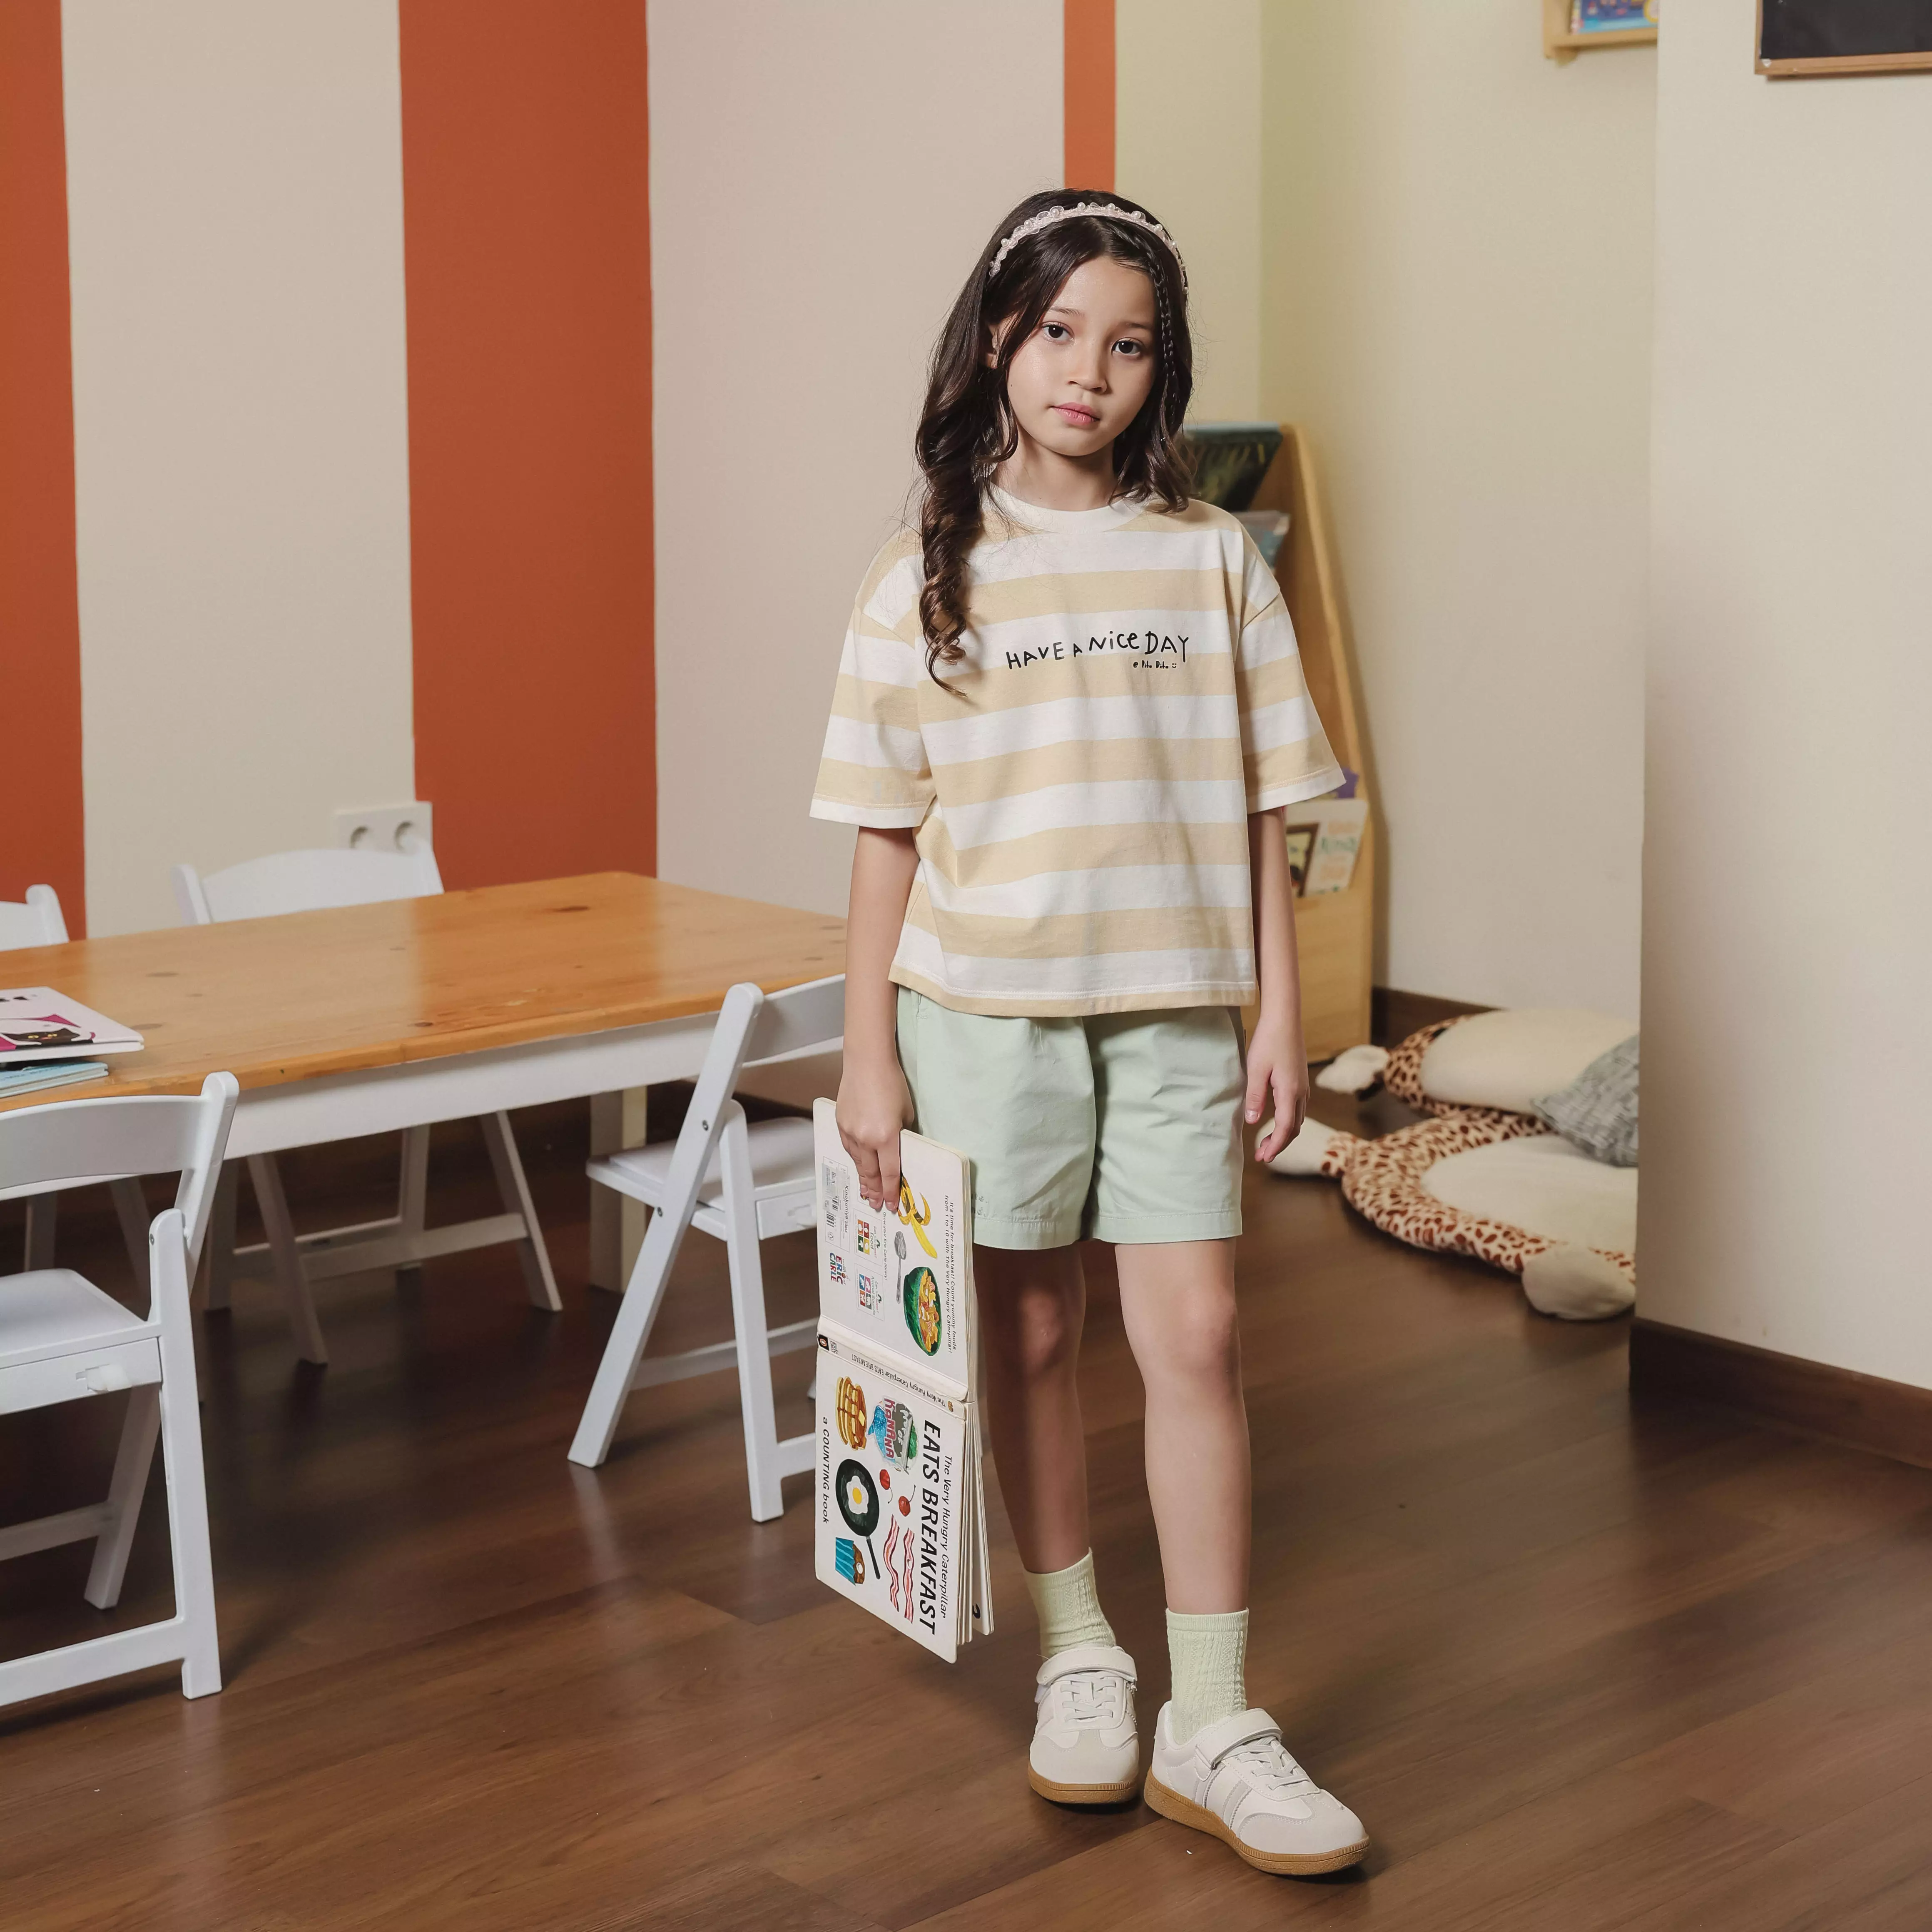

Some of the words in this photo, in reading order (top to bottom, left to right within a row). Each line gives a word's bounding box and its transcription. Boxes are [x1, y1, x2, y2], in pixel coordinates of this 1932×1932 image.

[1006, 642, 1065, 670] HAVE
[1073, 643, 1083, 657] A
[1145, 630, 1189, 662] DAY
[852, 1354, 874, 1370] BREAKFAST
[874, 1365, 884, 1376] EATS
[884, 1372, 909, 1388] Caterpillar
[909, 1382, 926, 1397] Hungry
[926, 1390, 937, 1402] Very
[937, 1397, 946, 1407] The
[922, 1420, 941, 1483] EATS
[942, 1479, 951, 1505] Very
[940, 1507, 950, 1551] Hungry
[919, 1488, 938, 1636] BREAKFAST
[939, 1554, 949, 1618] Caterpillar
